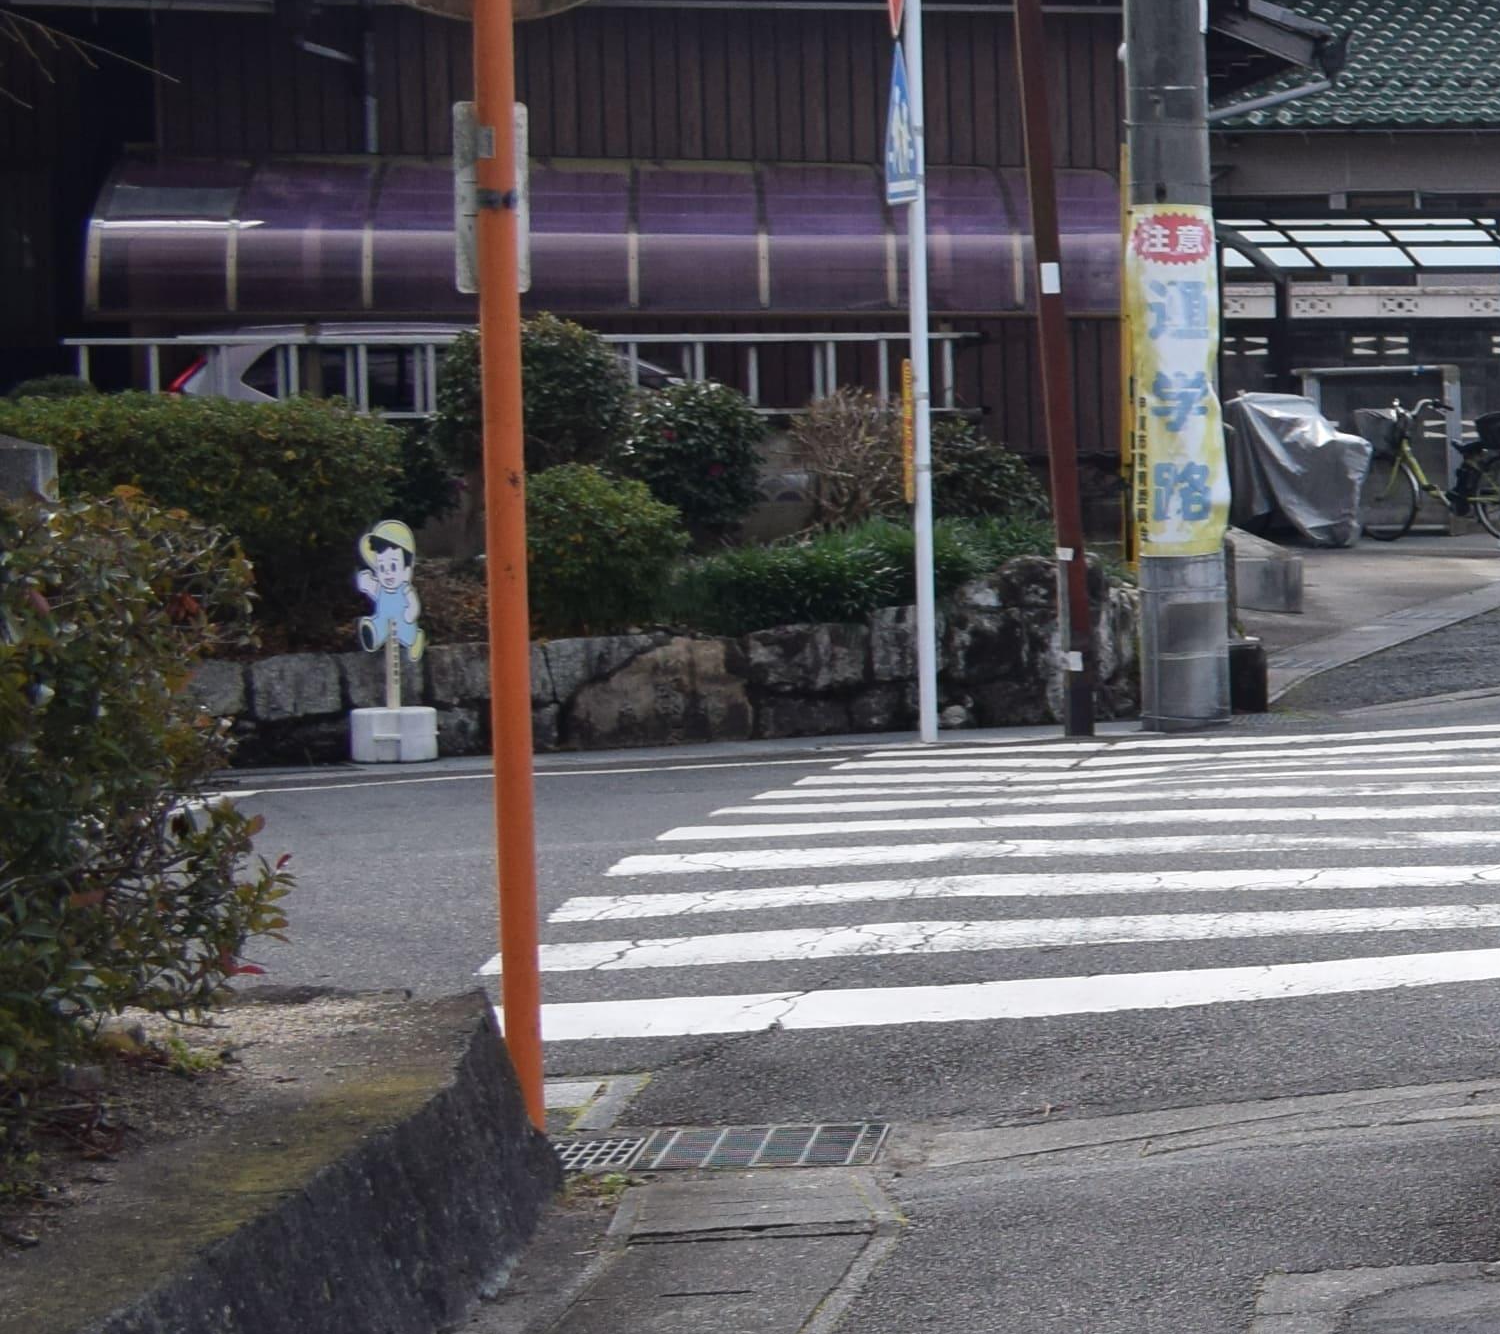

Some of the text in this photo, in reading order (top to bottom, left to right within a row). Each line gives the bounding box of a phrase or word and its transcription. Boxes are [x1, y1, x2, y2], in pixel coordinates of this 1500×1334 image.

[1142, 224, 1205, 254] 注意
[1146, 279, 1212, 522] 通学路
